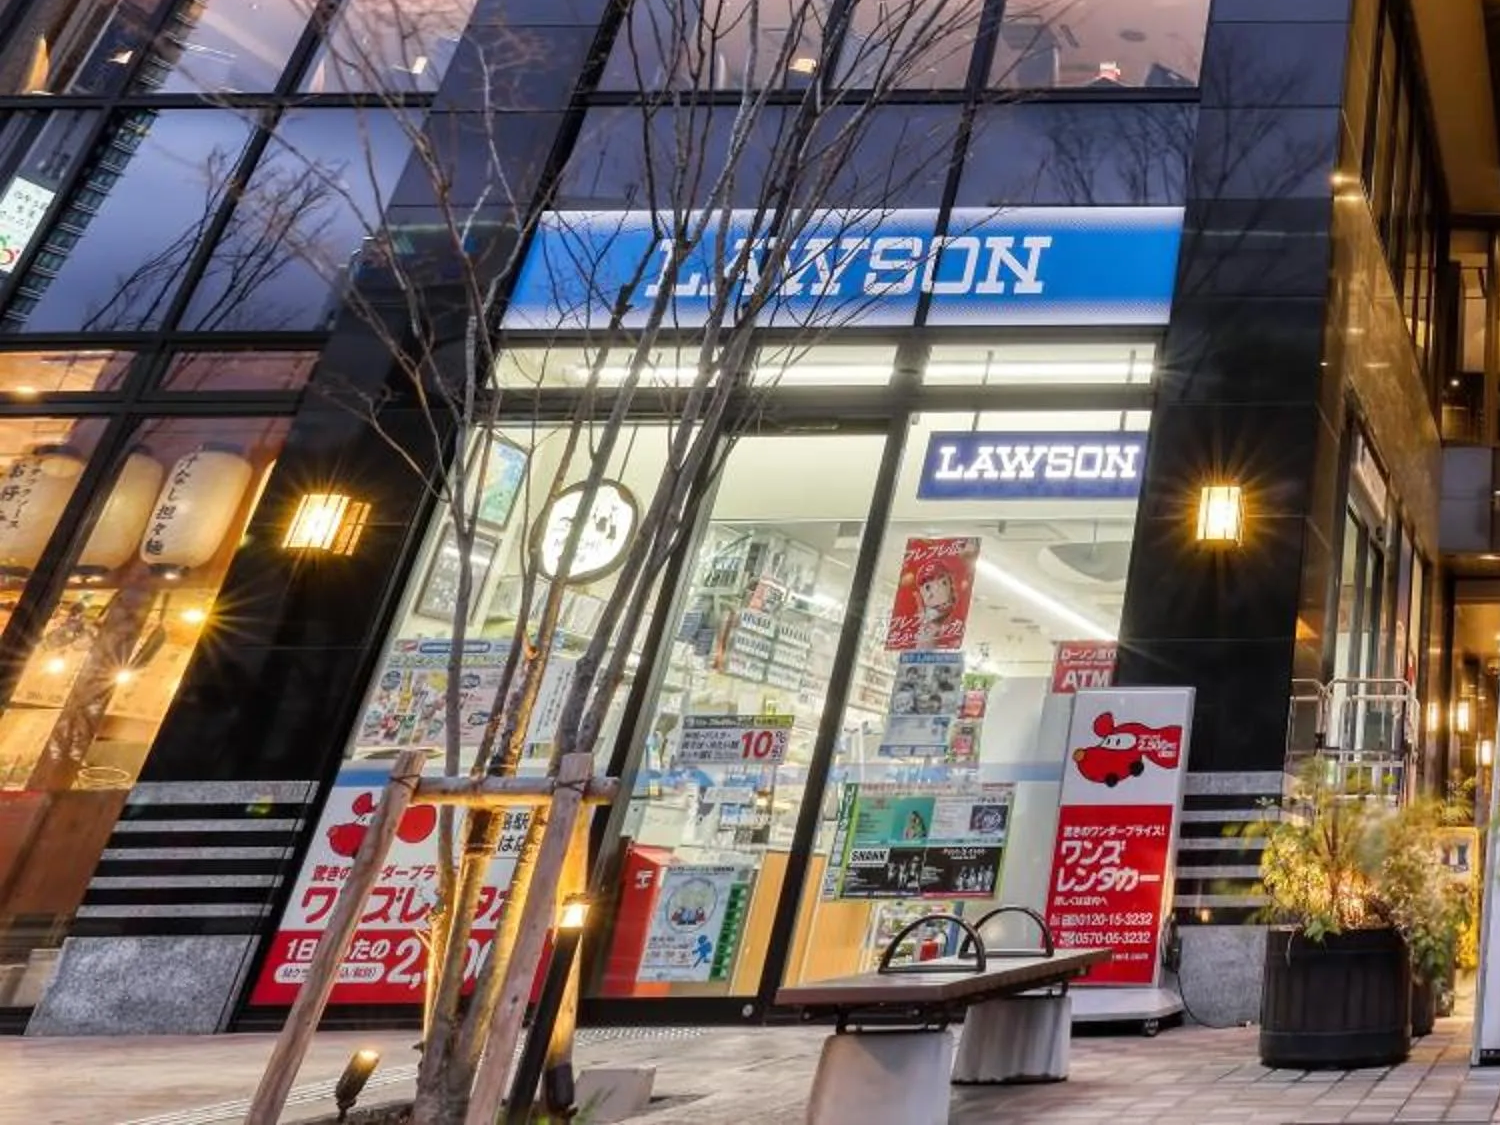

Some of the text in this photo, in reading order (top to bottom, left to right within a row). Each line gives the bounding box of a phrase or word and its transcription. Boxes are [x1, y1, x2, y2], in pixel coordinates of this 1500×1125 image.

[645, 236, 1052, 295] LAWSON
[935, 445, 1140, 479] LAWSON
[1061, 669, 1110, 690] ATM
[1061, 840, 1126, 864] ワンズ
[1056, 867, 1161, 892] レンタカー
